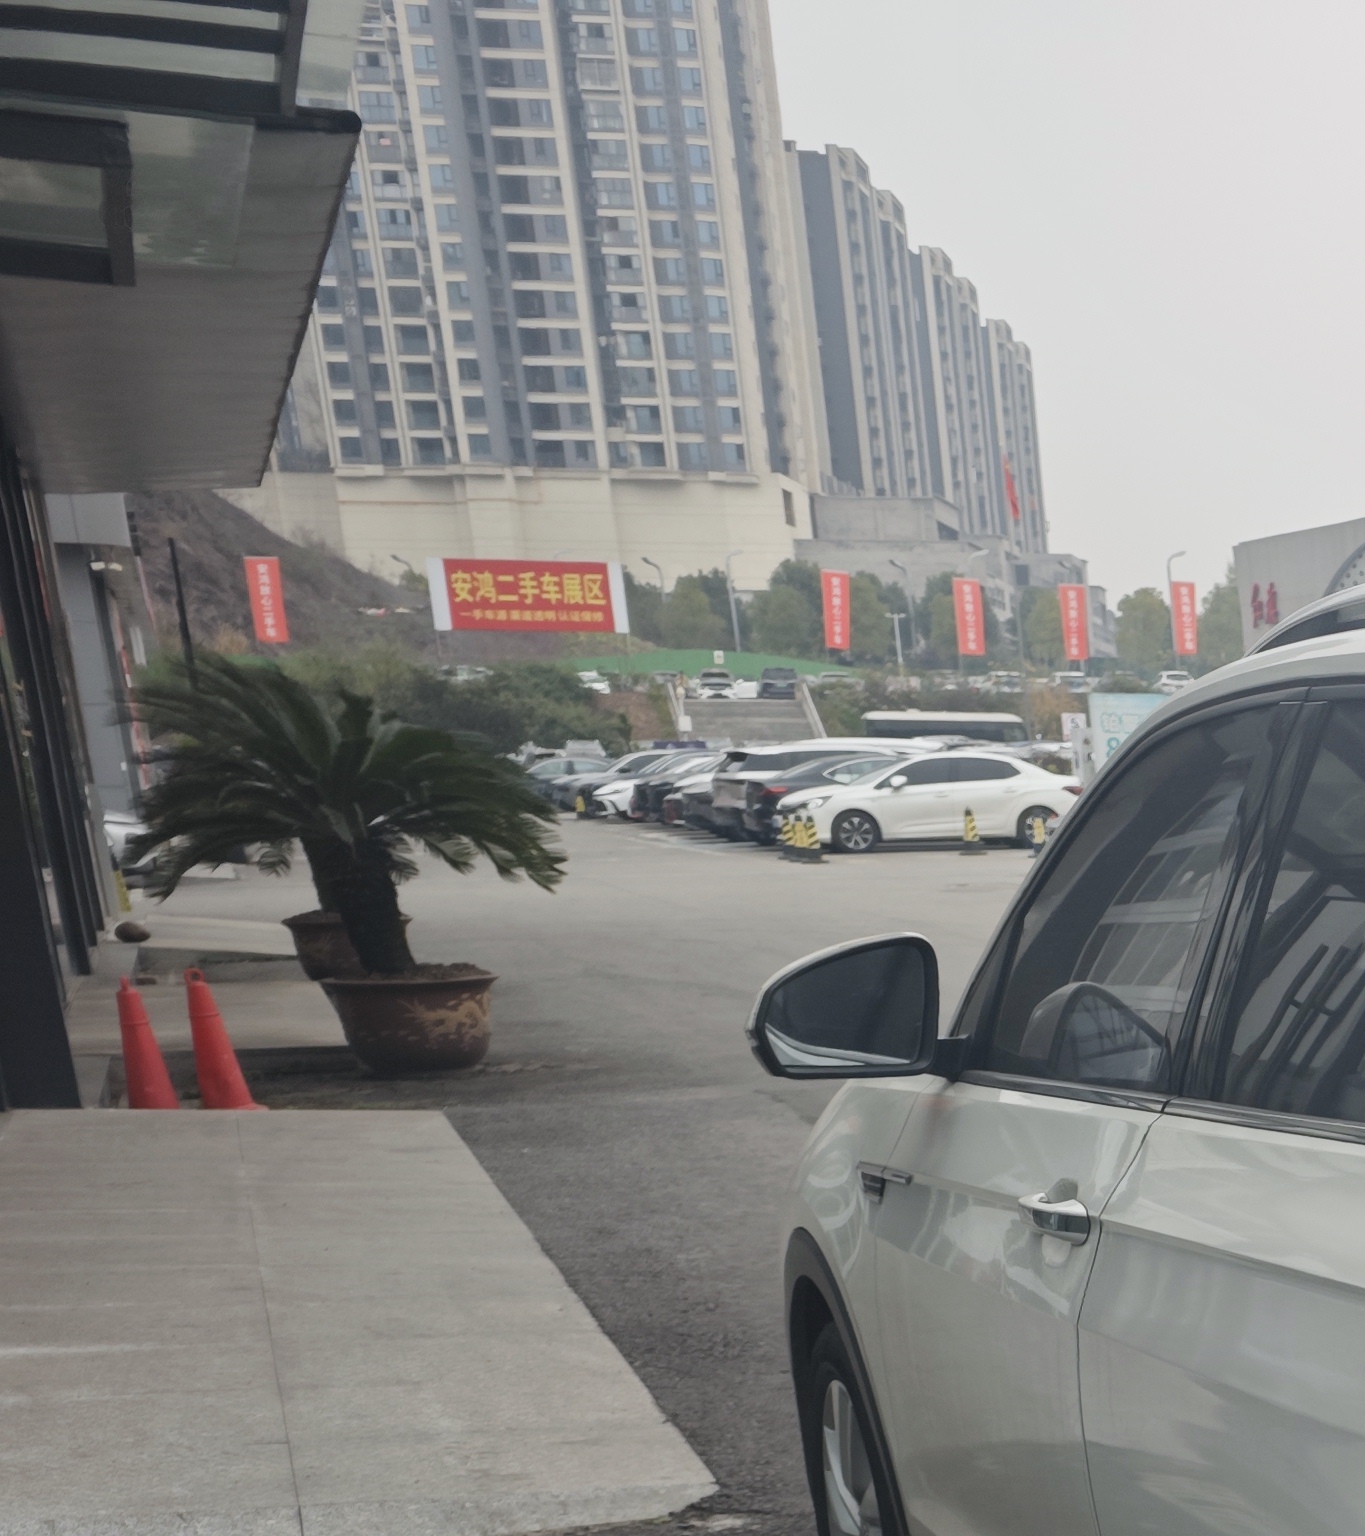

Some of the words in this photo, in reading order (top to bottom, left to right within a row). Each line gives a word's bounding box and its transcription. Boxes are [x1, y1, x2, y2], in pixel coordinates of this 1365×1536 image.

[451, 570, 607, 605] 安鸿二手车展区
